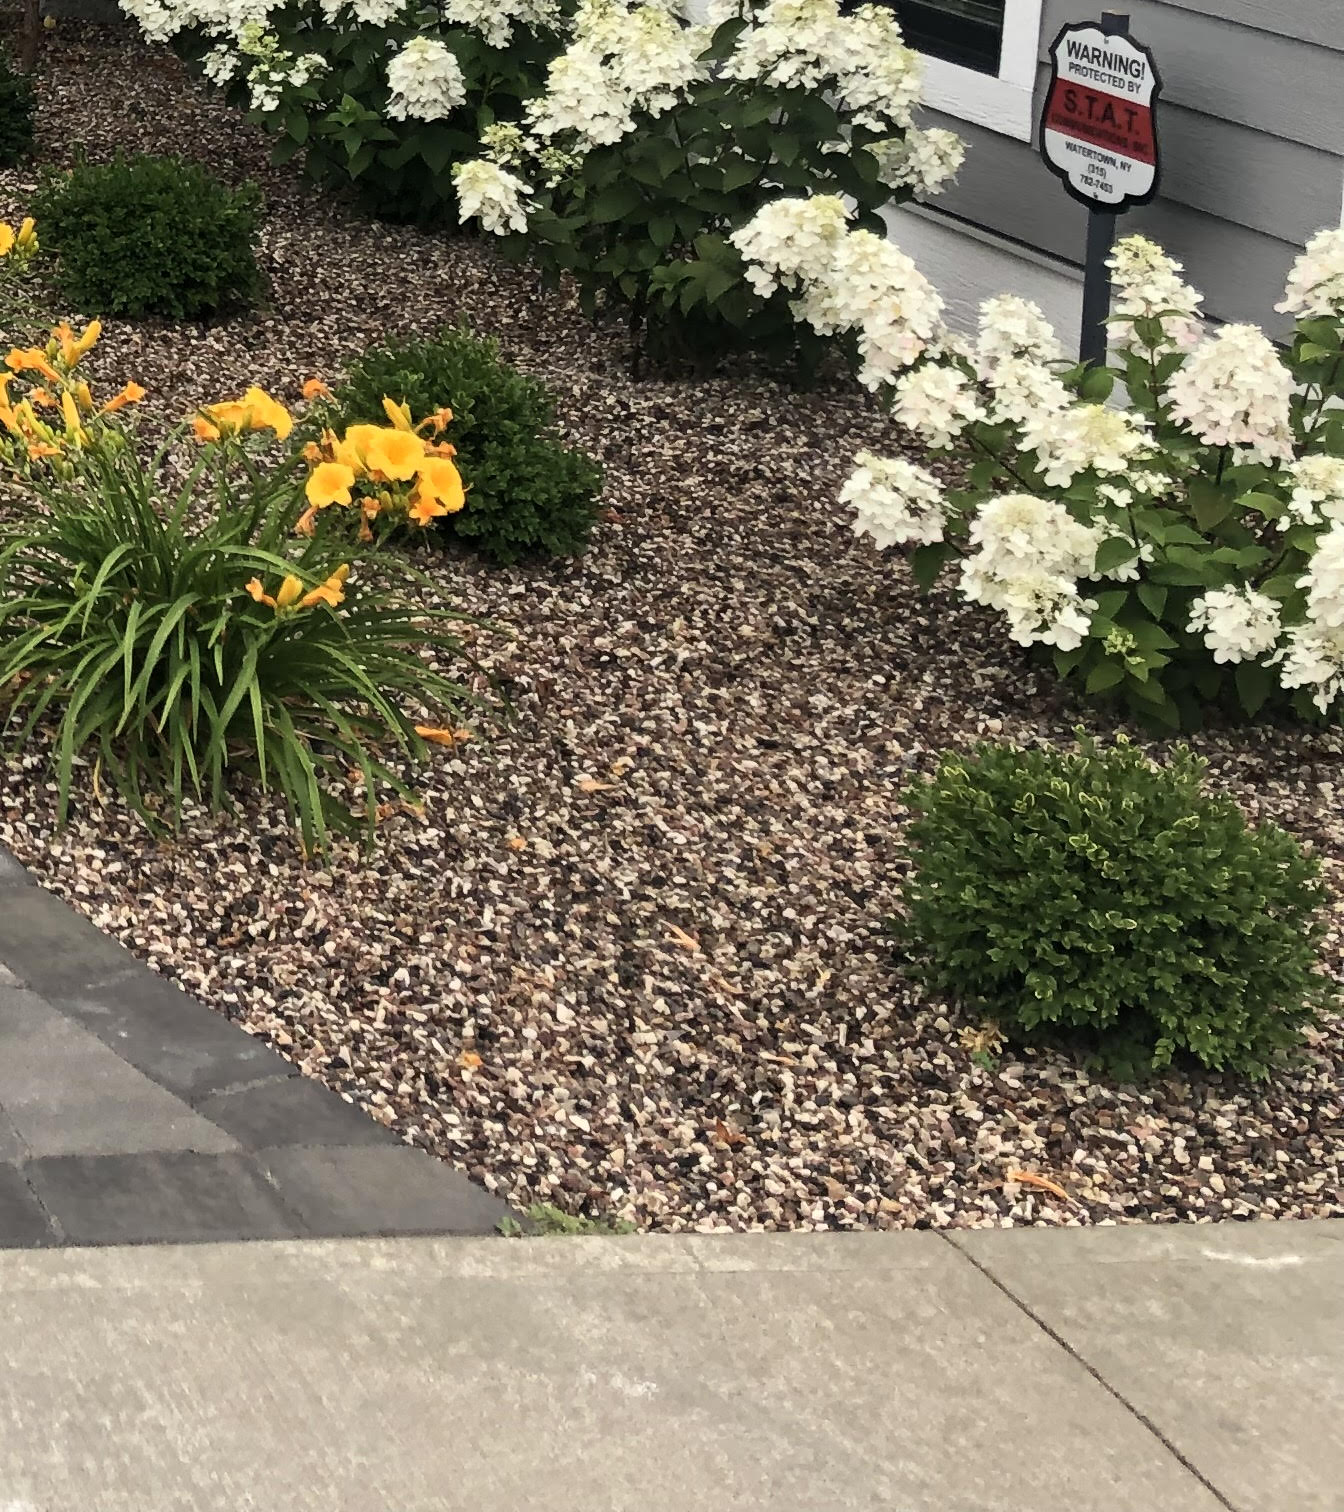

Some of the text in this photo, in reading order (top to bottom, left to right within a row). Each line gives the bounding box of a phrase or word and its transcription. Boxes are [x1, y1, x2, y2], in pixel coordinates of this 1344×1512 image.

[1066, 39, 1146, 81] WARNING!
[1068, 61, 1142, 94] PROTECTED BY
[1064, 89, 1140, 136] S.T.A.T.
[1065, 140, 1119, 170] WATERTOWN,
[1120, 160, 1132, 173] NY
